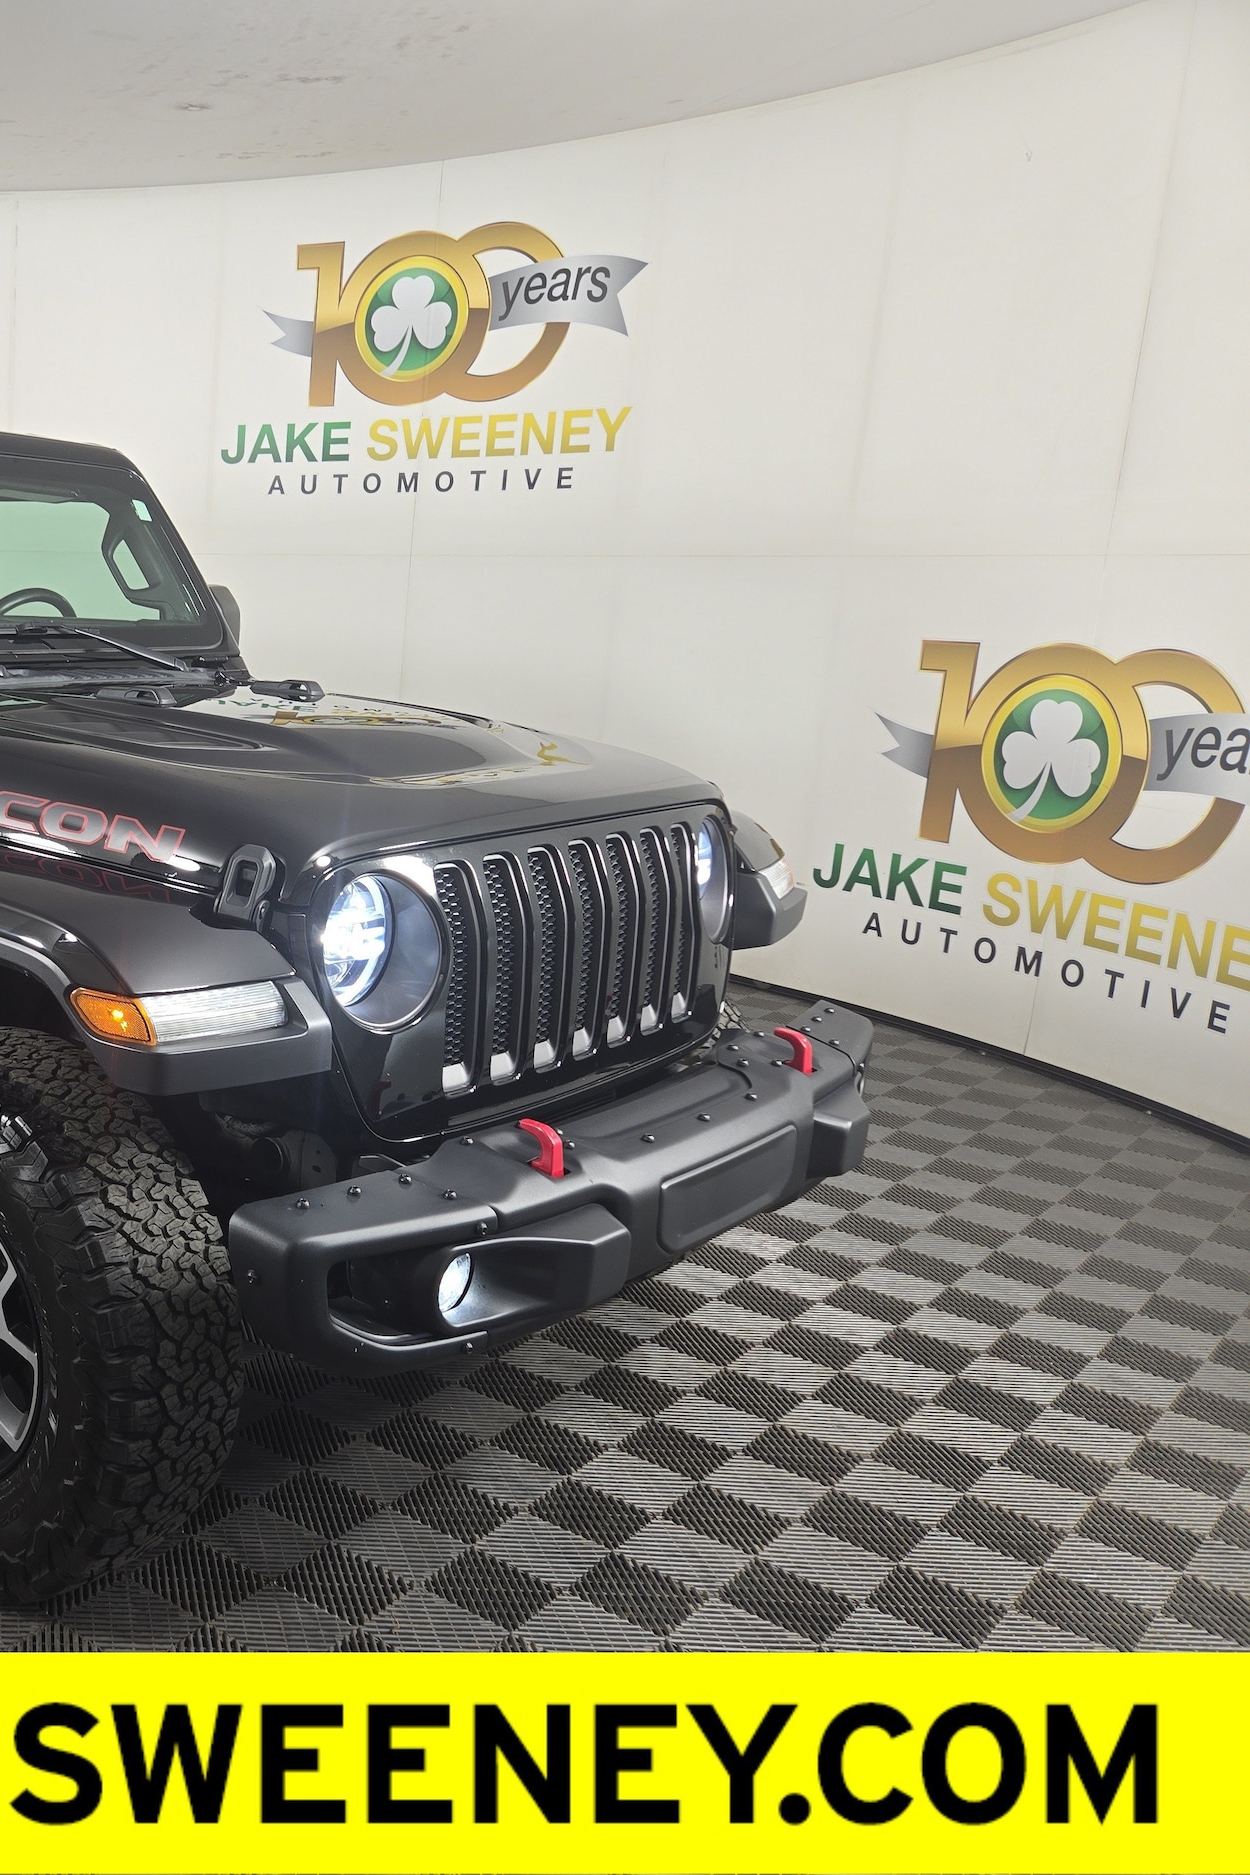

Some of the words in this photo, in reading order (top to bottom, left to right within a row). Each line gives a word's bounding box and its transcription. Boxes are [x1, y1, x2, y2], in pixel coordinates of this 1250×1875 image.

[497, 265, 612, 321] years
[221, 421, 352, 464] JAKE
[366, 406, 633, 461] SWEENEY
[268, 467, 574, 495] AUTOMOTIVE
[812, 842, 968, 915] JAKE
[862, 912, 1231, 1034] AUTOMOTIVE
